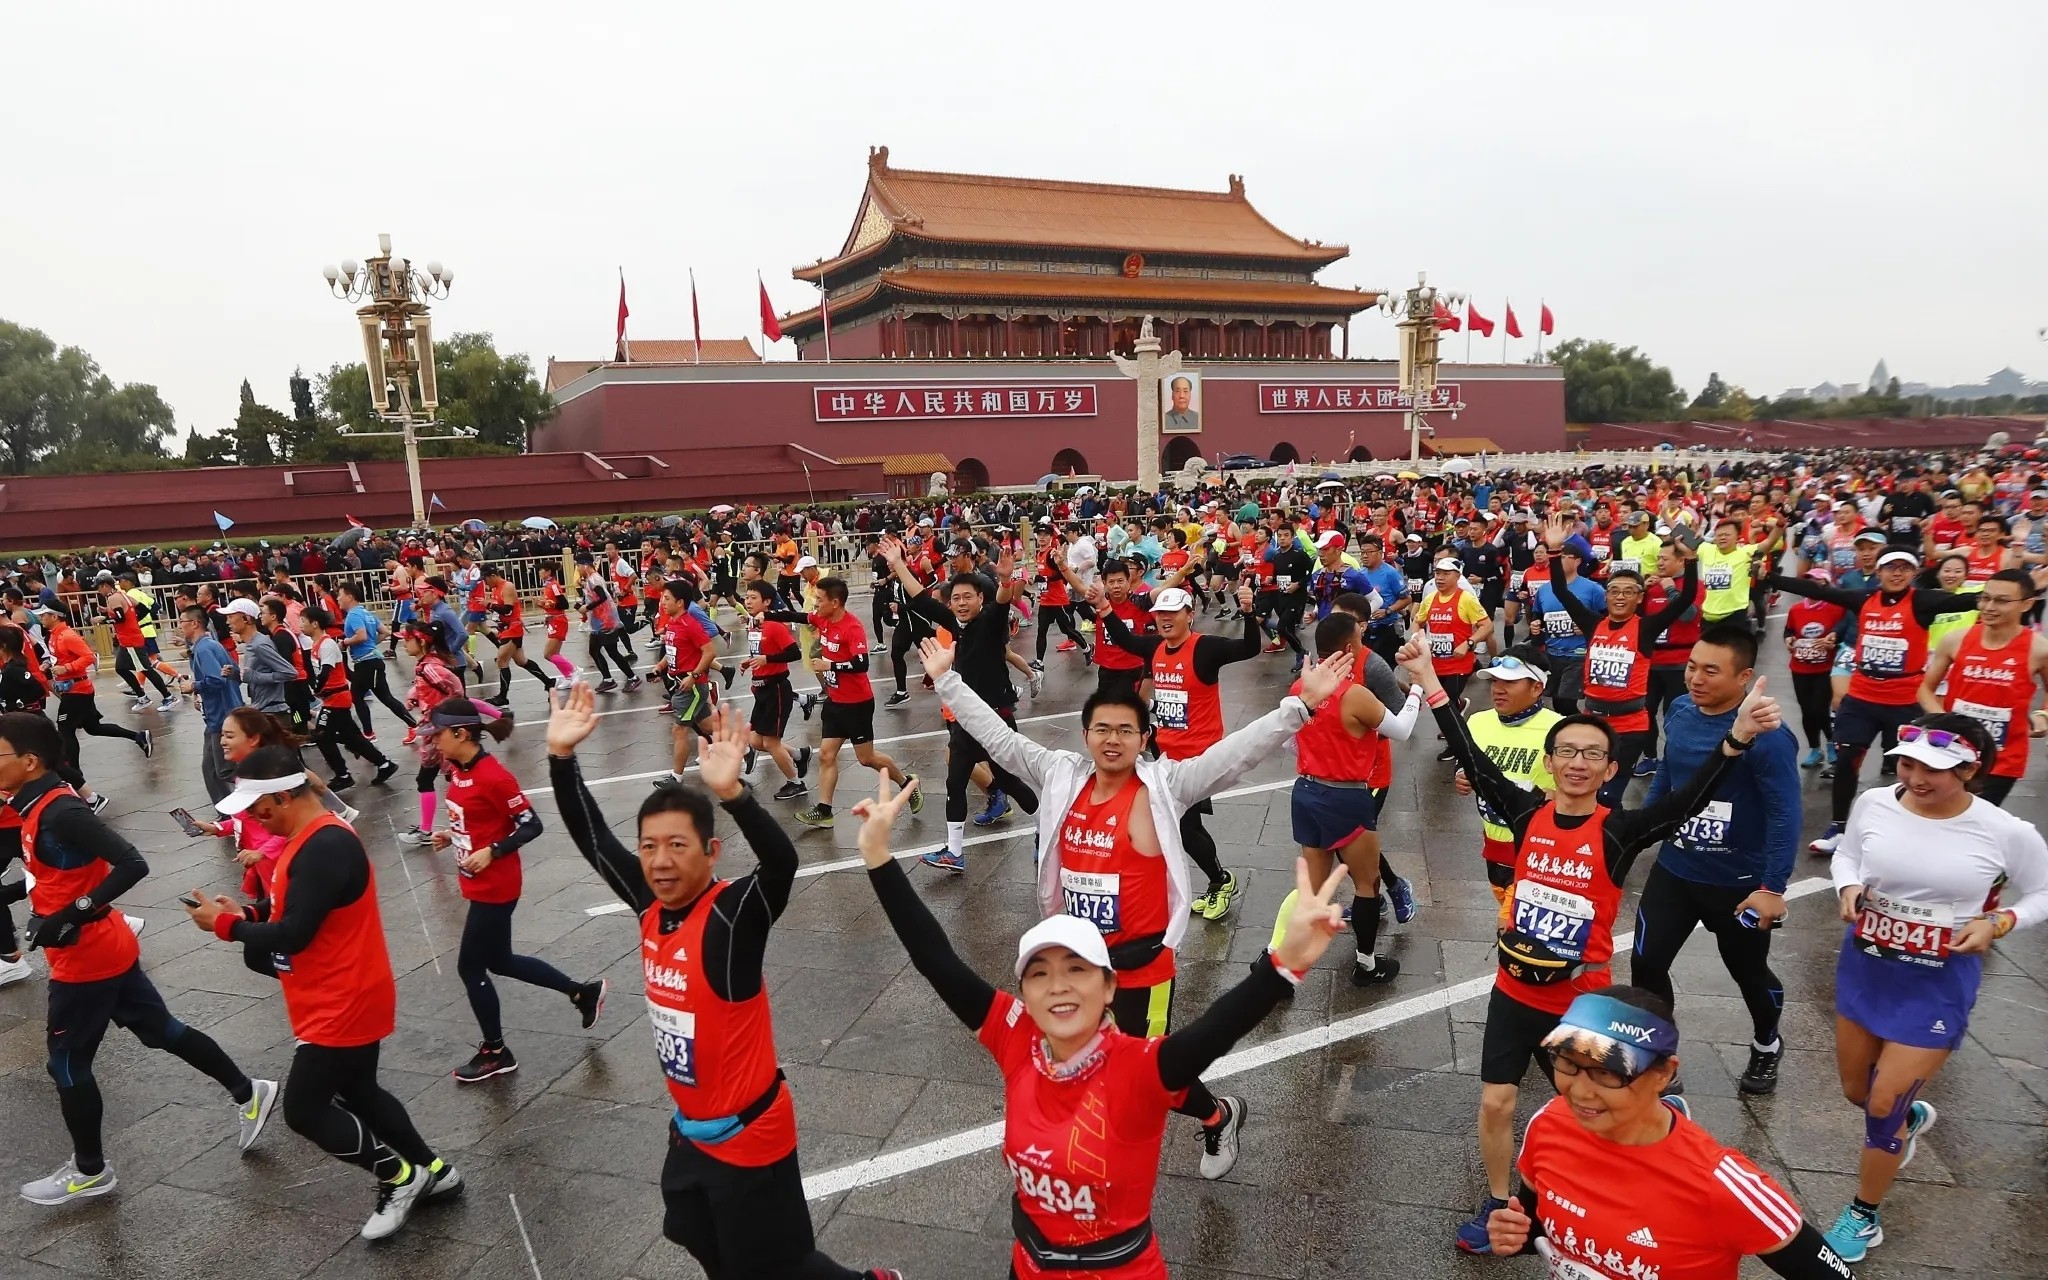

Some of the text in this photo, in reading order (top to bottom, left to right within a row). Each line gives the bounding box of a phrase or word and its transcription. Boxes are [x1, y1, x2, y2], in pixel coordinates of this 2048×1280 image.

[831, 390, 1083, 416] 中华人民共和国万岁
[1547, 620, 1573, 632] F2167
[1862, 646, 1904, 664] D0565
[1590, 659, 1629, 678] F3105
[1065, 825, 1115, 850] 北京马拉松
[1526, 851, 1594, 880] 北京马拉松
[1542, 891, 1577, 909] 华夏幸福
[1892, 902, 1933, 917] 华夏幸福
[1516, 901, 1584, 941] F1427
[1862, 910, 1942, 951] D8941
[1543, 1216, 1661, 1280] 北京马拉松
[1817, 1244, 1851, 1279] ENCINO
